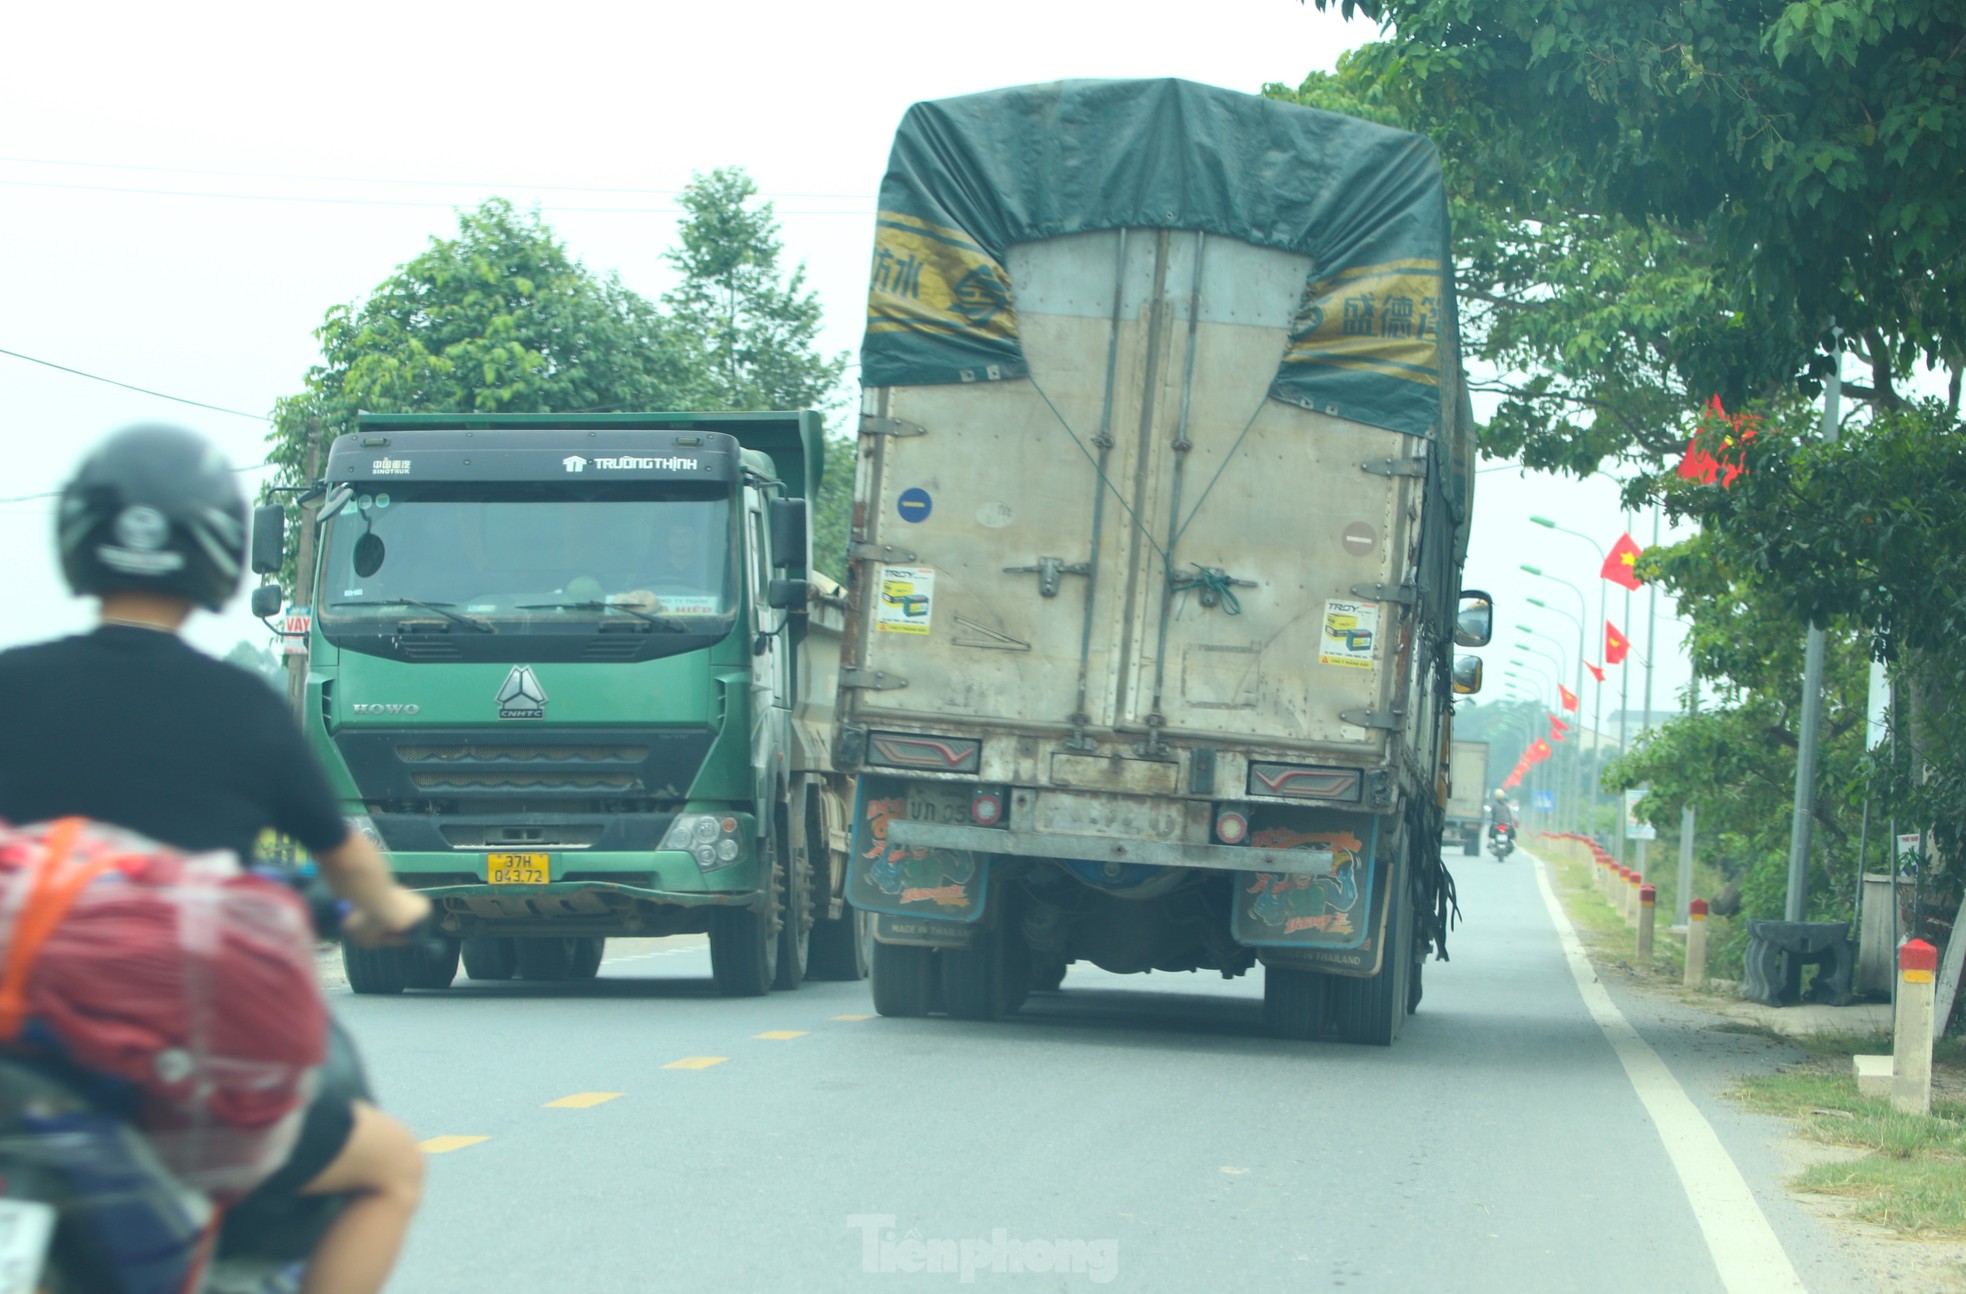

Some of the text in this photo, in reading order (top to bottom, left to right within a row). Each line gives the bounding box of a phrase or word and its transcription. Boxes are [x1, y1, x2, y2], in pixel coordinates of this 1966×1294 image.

[1329, 603, 1360, 612] TROY
[353, 703, 420, 715] HOWO
[501, 710, 542, 718] CNHTC
[506, 855, 531, 868] 37H
[1316, 952, 1361, 966] THAILAND
